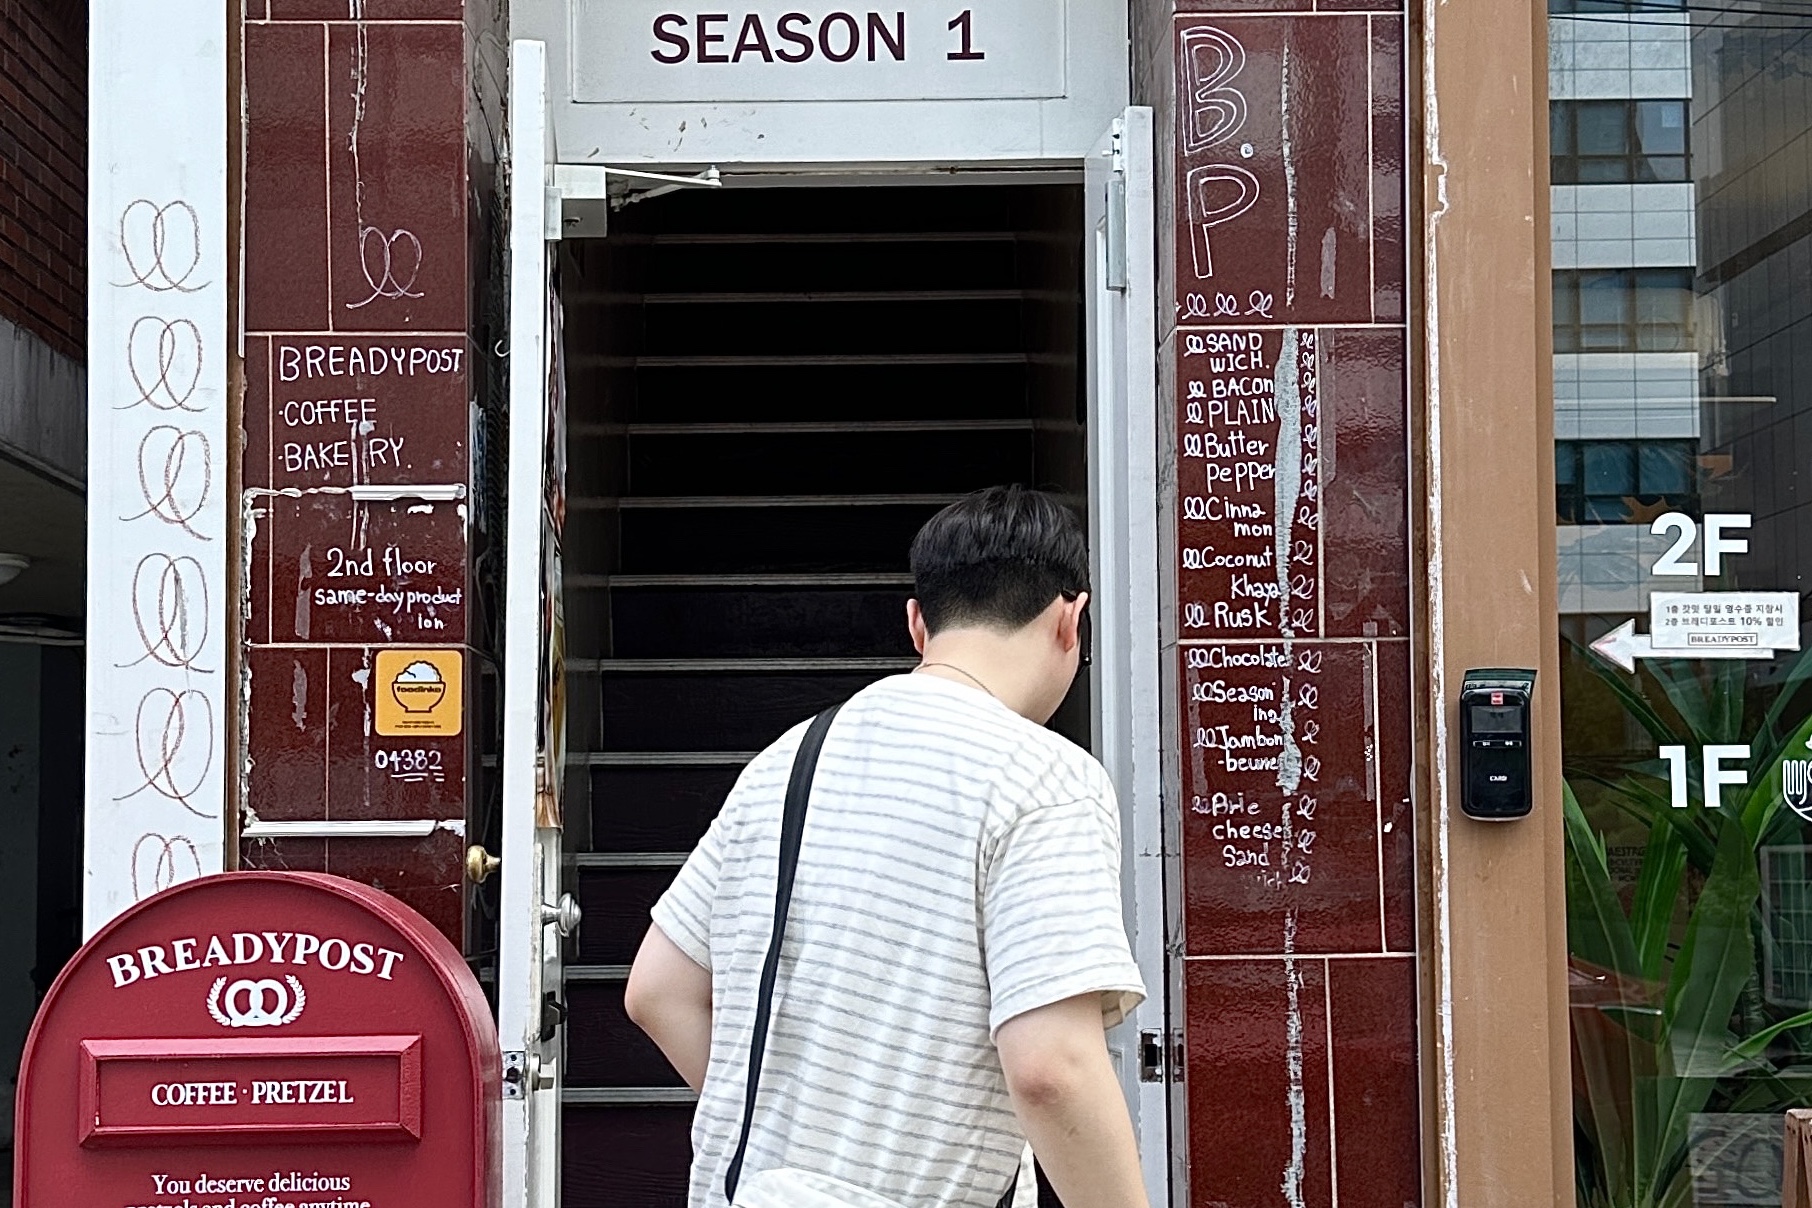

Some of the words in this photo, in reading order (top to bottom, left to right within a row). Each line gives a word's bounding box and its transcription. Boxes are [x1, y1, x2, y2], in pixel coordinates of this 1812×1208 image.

[651, 11, 905, 65] SEASON
[946, 9, 985, 61] 1
[1206, 332, 1262, 353] SAND
[280, 346, 464, 381] BREADYPOST
[1210, 350, 1270, 373] WICH.
[284, 398, 377, 426] COFFEE
[1207, 397, 1275, 428] PLAIN
[1204, 429, 1269, 458] Butter
[1205, 496, 1266, 520] Cinna
[1233, 521, 1273, 537] mon
[1650, 512, 1752, 576] 2F
[327, 547, 373, 577] 2nd
[382, 546, 437, 577] floor
[1202, 545, 1273, 568] Coconut
[1214, 601, 1272, 628] Rusk
[1666, 604, 1679, 614] 1층
[1755, 604, 1783, 614] 지참시
[418, 613, 444, 630] ion
[1665, 617, 1679, 626] 2층
[1682, 616, 1737, 626] 브레디포스트
[1740, 616, 1762, 626] 10%
[1766, 616, 1784, 627] 할인
[1690, 635, 1755, 643] BREADYPOST
[1210, 645, 1287, 668] Chocolate
[1213, 680, 1274, 703] Season
[1215, 725, 1283, 750] Jambon
[375, 749, 443, 771] 04382
[1659, 744, 1750, 808] 1F
[1222, 842, 1270, 867] Sand
[106, 931, 404, 989] BREADYPOST
[151, 1081, 238, 1106] COFFEE
[250, 1080, 354, 1104] PRETZEL
[151, 1174, 191, 1195] You
[194, 1173, 265, 1194] deserve
[268, 1172, 351, 1192] delicious
